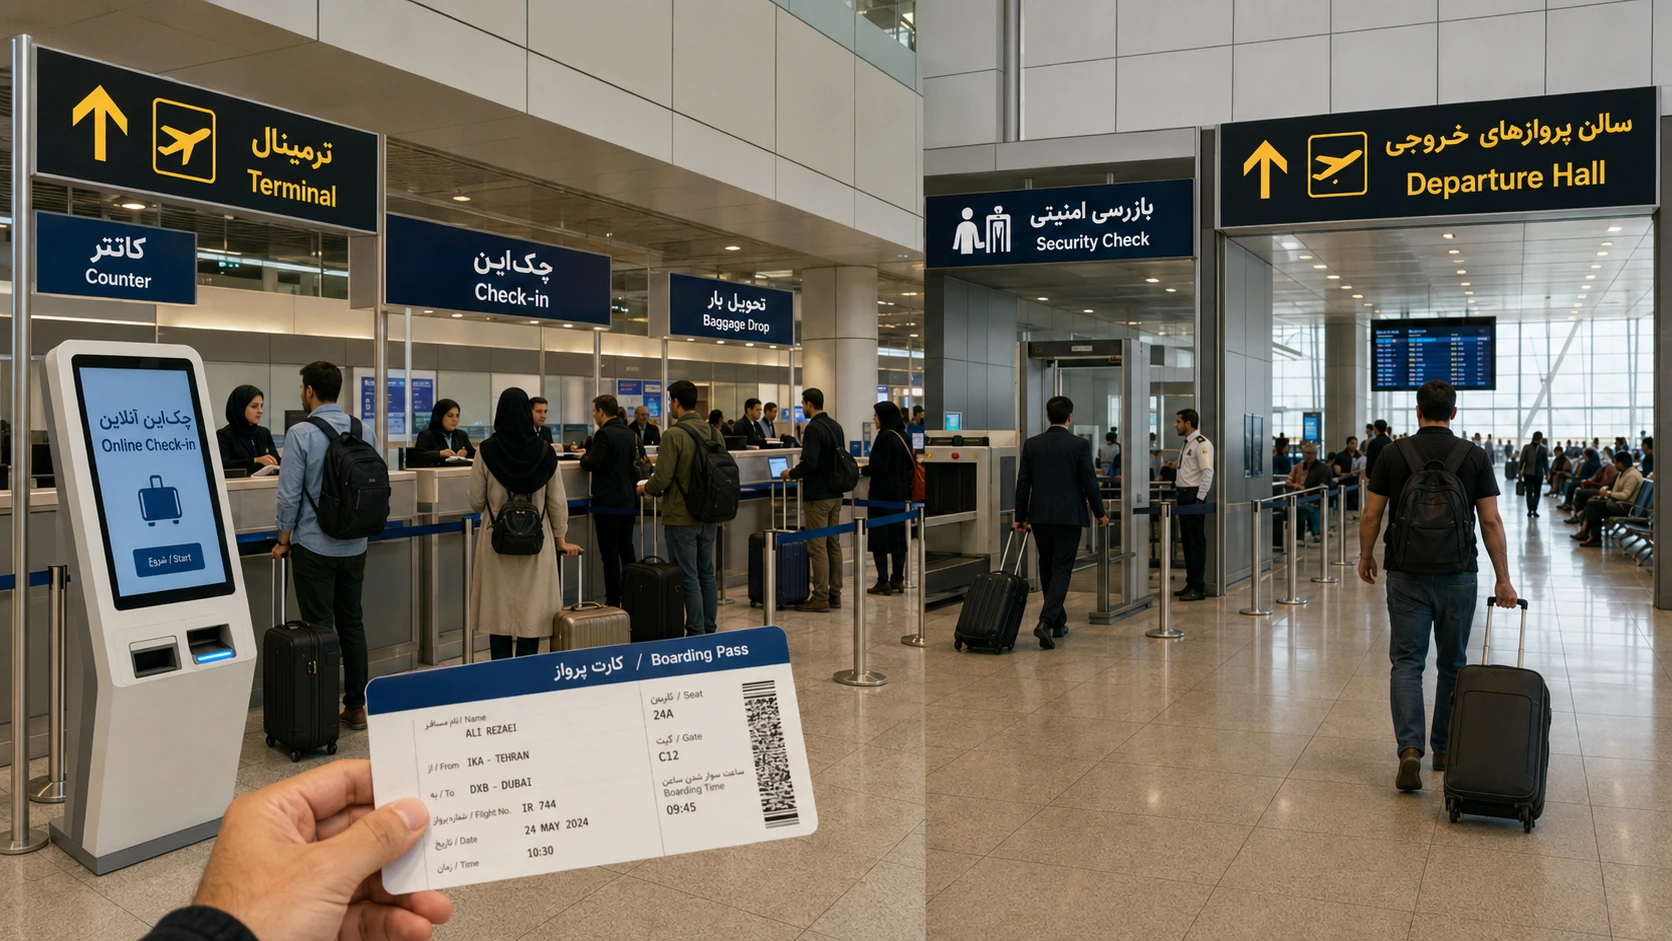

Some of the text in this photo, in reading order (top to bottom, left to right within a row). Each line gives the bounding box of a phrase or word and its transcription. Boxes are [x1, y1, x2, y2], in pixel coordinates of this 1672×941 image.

[1385, 112, 1632, 157] سالن پروازهای خروجی
[251, 126, 333, 170] ترمینال
[1407, 159, 1605, 200] Departure Hall
[247, 168, 336, 208] Terminal
[1030, 197, 1154, 228] بازرسی امنیتی
[1036, 231, 1150, 252] Security Check
[85, 268, 152, 289] Counter
[474, 282, 549, 308] Check-in
[707, 290, 766, 314] تحویل بار
[703, 313, 770, 335] Baggage Drop
[100, 409, 139, 430] آنلاین
[101, 437, 196, 453] Online Check-in
[172, 553, 192, 563] Start
[651, 649, 713, 667] Boarding
[716, 645, 749, 659] Pass
[553, 662, 587, 681] پرواز
[591, 656, 624, 676] کارت
[683, 690, 704, 700] Seat
[464, 714, 487, 723] Name
[653, 708, 674, 720] 24A
[465, 723, 517, 738] ALI REZAEI
[682, 733, 703, 742] Gate
[467, 757, 484, 767] IKA
[495, 751, 529, 763] TEHRAN
[658, 750, 679, 762] C12
[440, 762, 459, 771] From
[445, 789, 455, 797] To
[470, 783, 489, 794] DXB
[501, 777, 532, 790] DUBAI
[663, 783, 725, 797] Boarding Time
[475, 809, 497, 819] Flight
[498, 807, 511, 816] No.
[522, 799, 556, 813] IR 744
[666, 802, 696, 815] 09:45
[524, 817, 589, 835] 24 MAY 2024
[460, 836, 478, 845] Date
[527, 845, 554, 858] 10:30
[460, 860, 479, 869] Time
